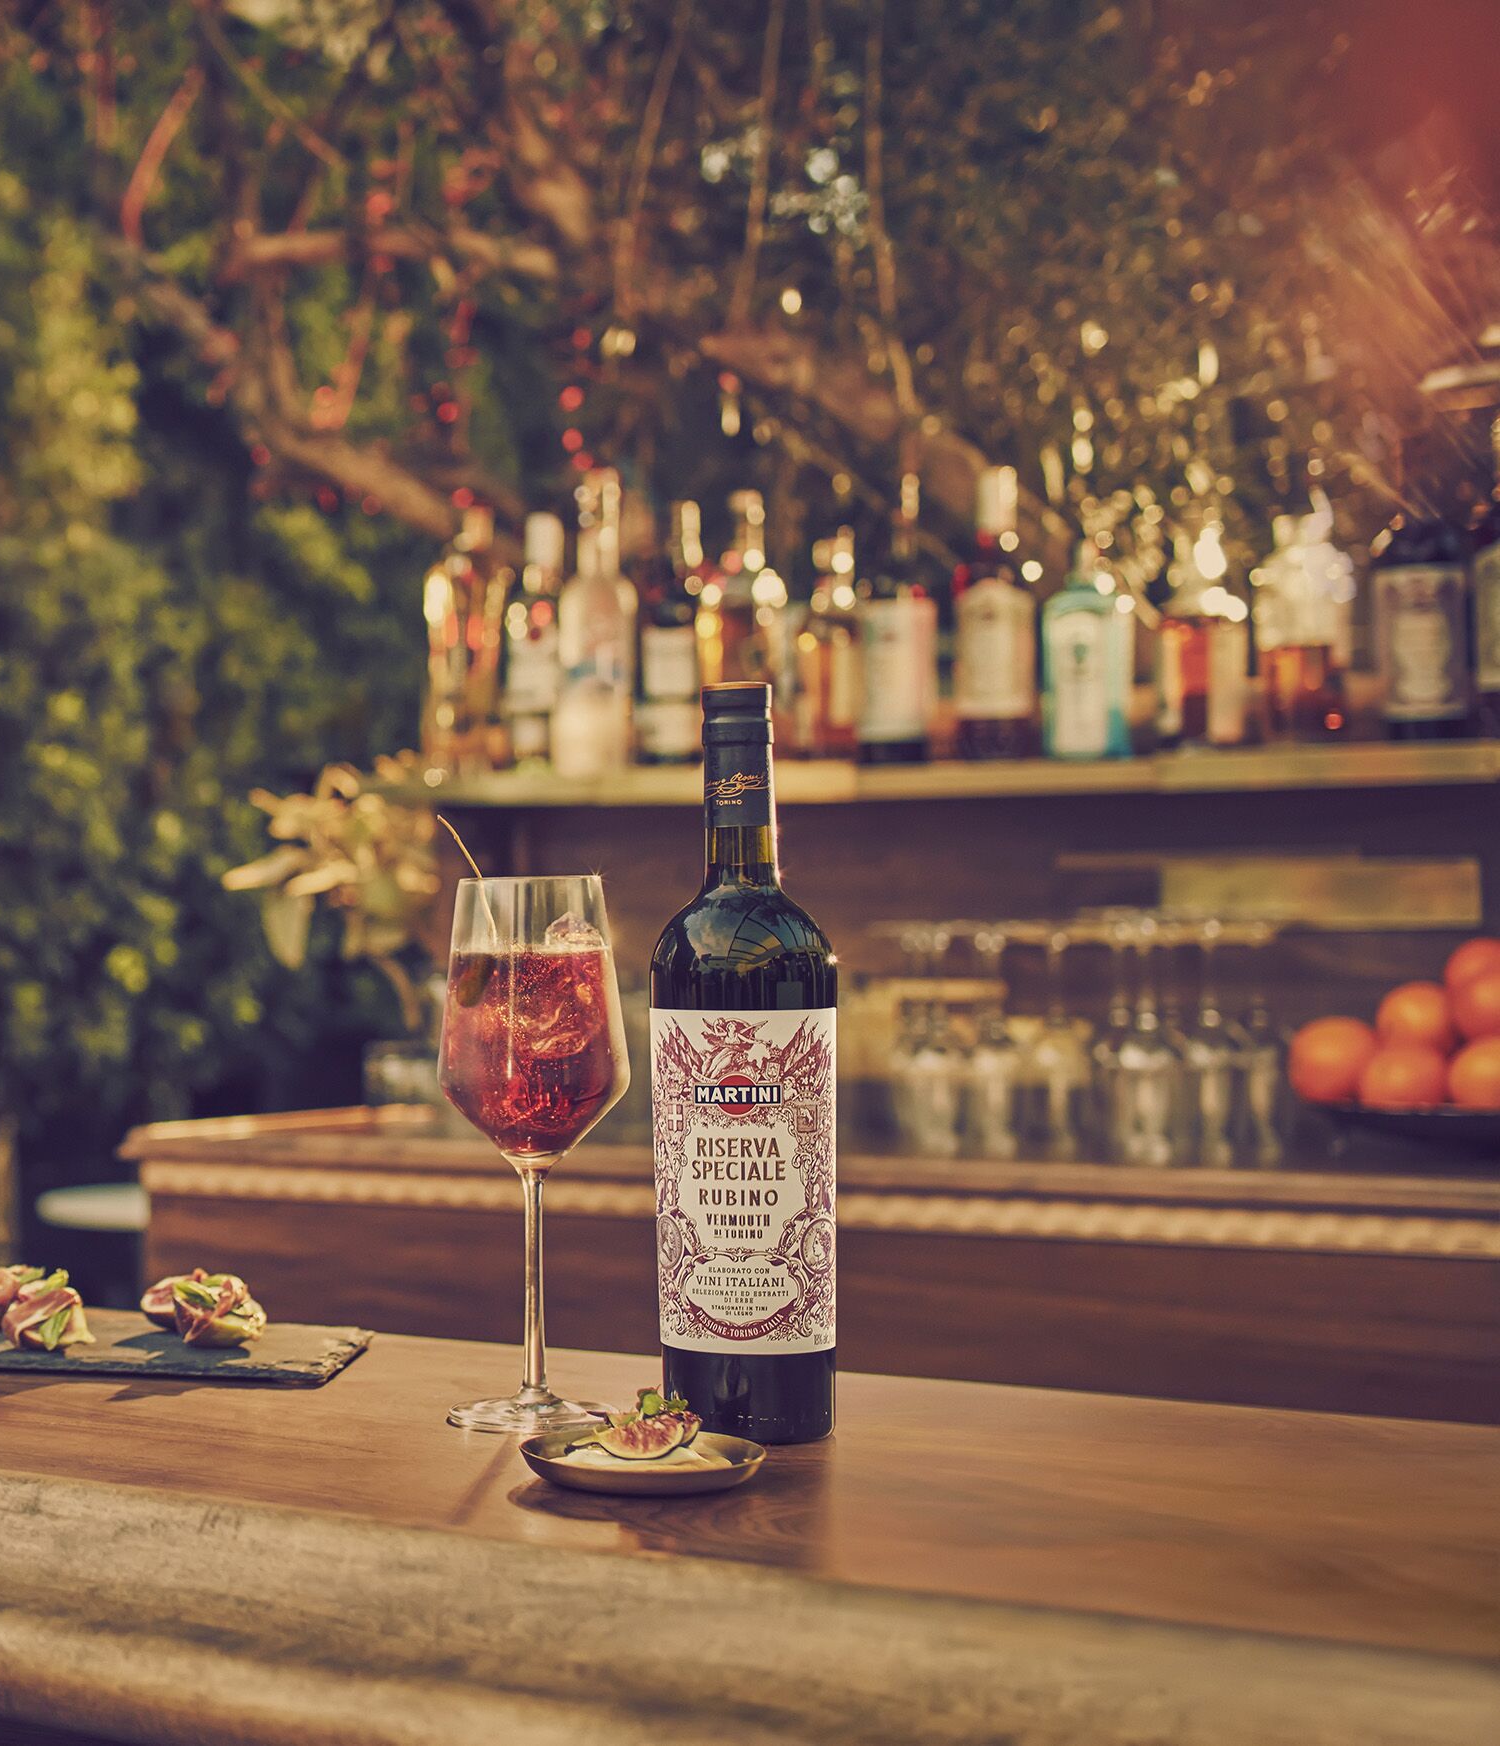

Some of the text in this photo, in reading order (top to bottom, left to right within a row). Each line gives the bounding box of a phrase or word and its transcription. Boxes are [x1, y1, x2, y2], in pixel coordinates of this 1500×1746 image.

[697, 1086, 778, 1103] MARTINI
[696, 1137, 781, 1158] RISERVA
[691, 1160, 786, 1181] SPECIALE
[699, 1188, 779, 1206] RUBINO
[706, 1213, 770, 1227] VERMOUTH
[724, 1229, 763, 1239] TORINO
[696, 1275, 785, 1287] VINI ITALIANI
[692, 1288, 737, 1297] SELEZIONATI
